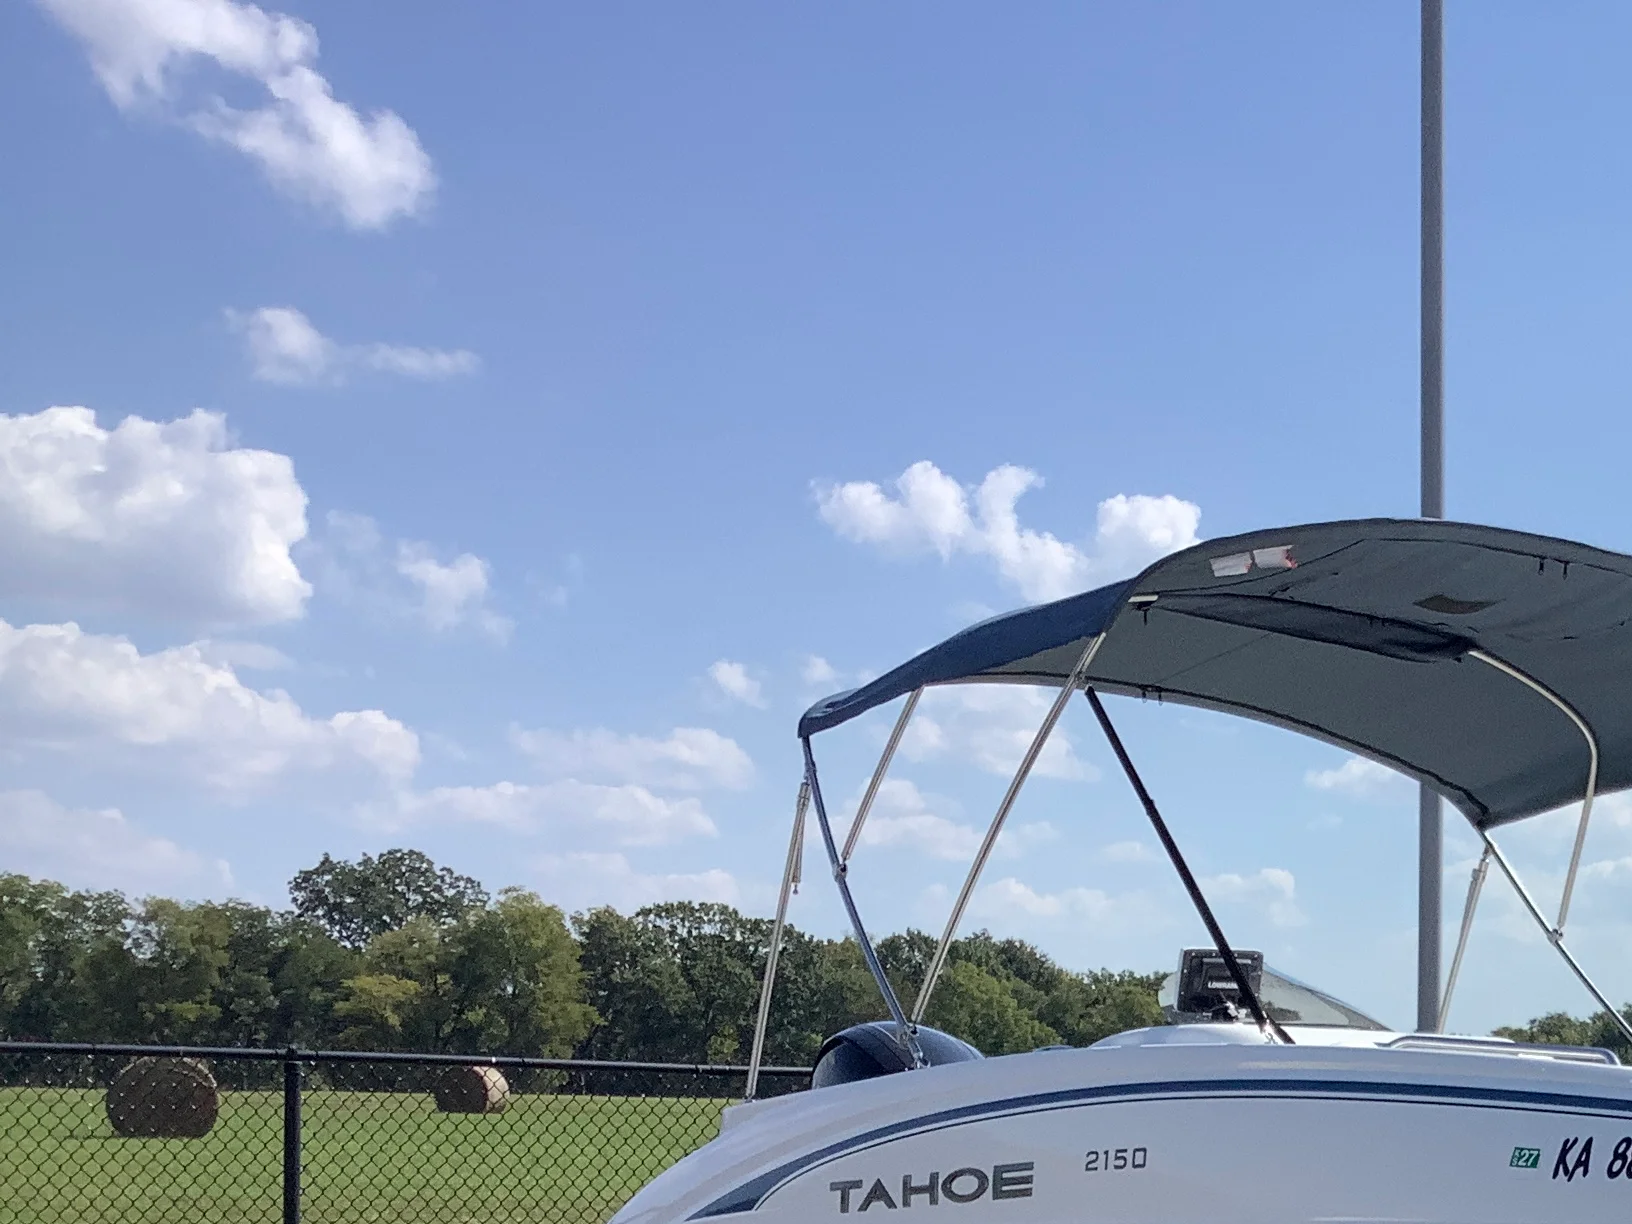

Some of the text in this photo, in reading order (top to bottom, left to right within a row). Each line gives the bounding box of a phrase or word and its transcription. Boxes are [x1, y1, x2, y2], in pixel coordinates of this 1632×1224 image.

[1084, 1147, 1148, 1172] 2150
[1517, 1149, 1540, 1167] 27
[1551, 1136, 1594, 1183] KA
[829, 1161, 1035, 1214] TAHOE
